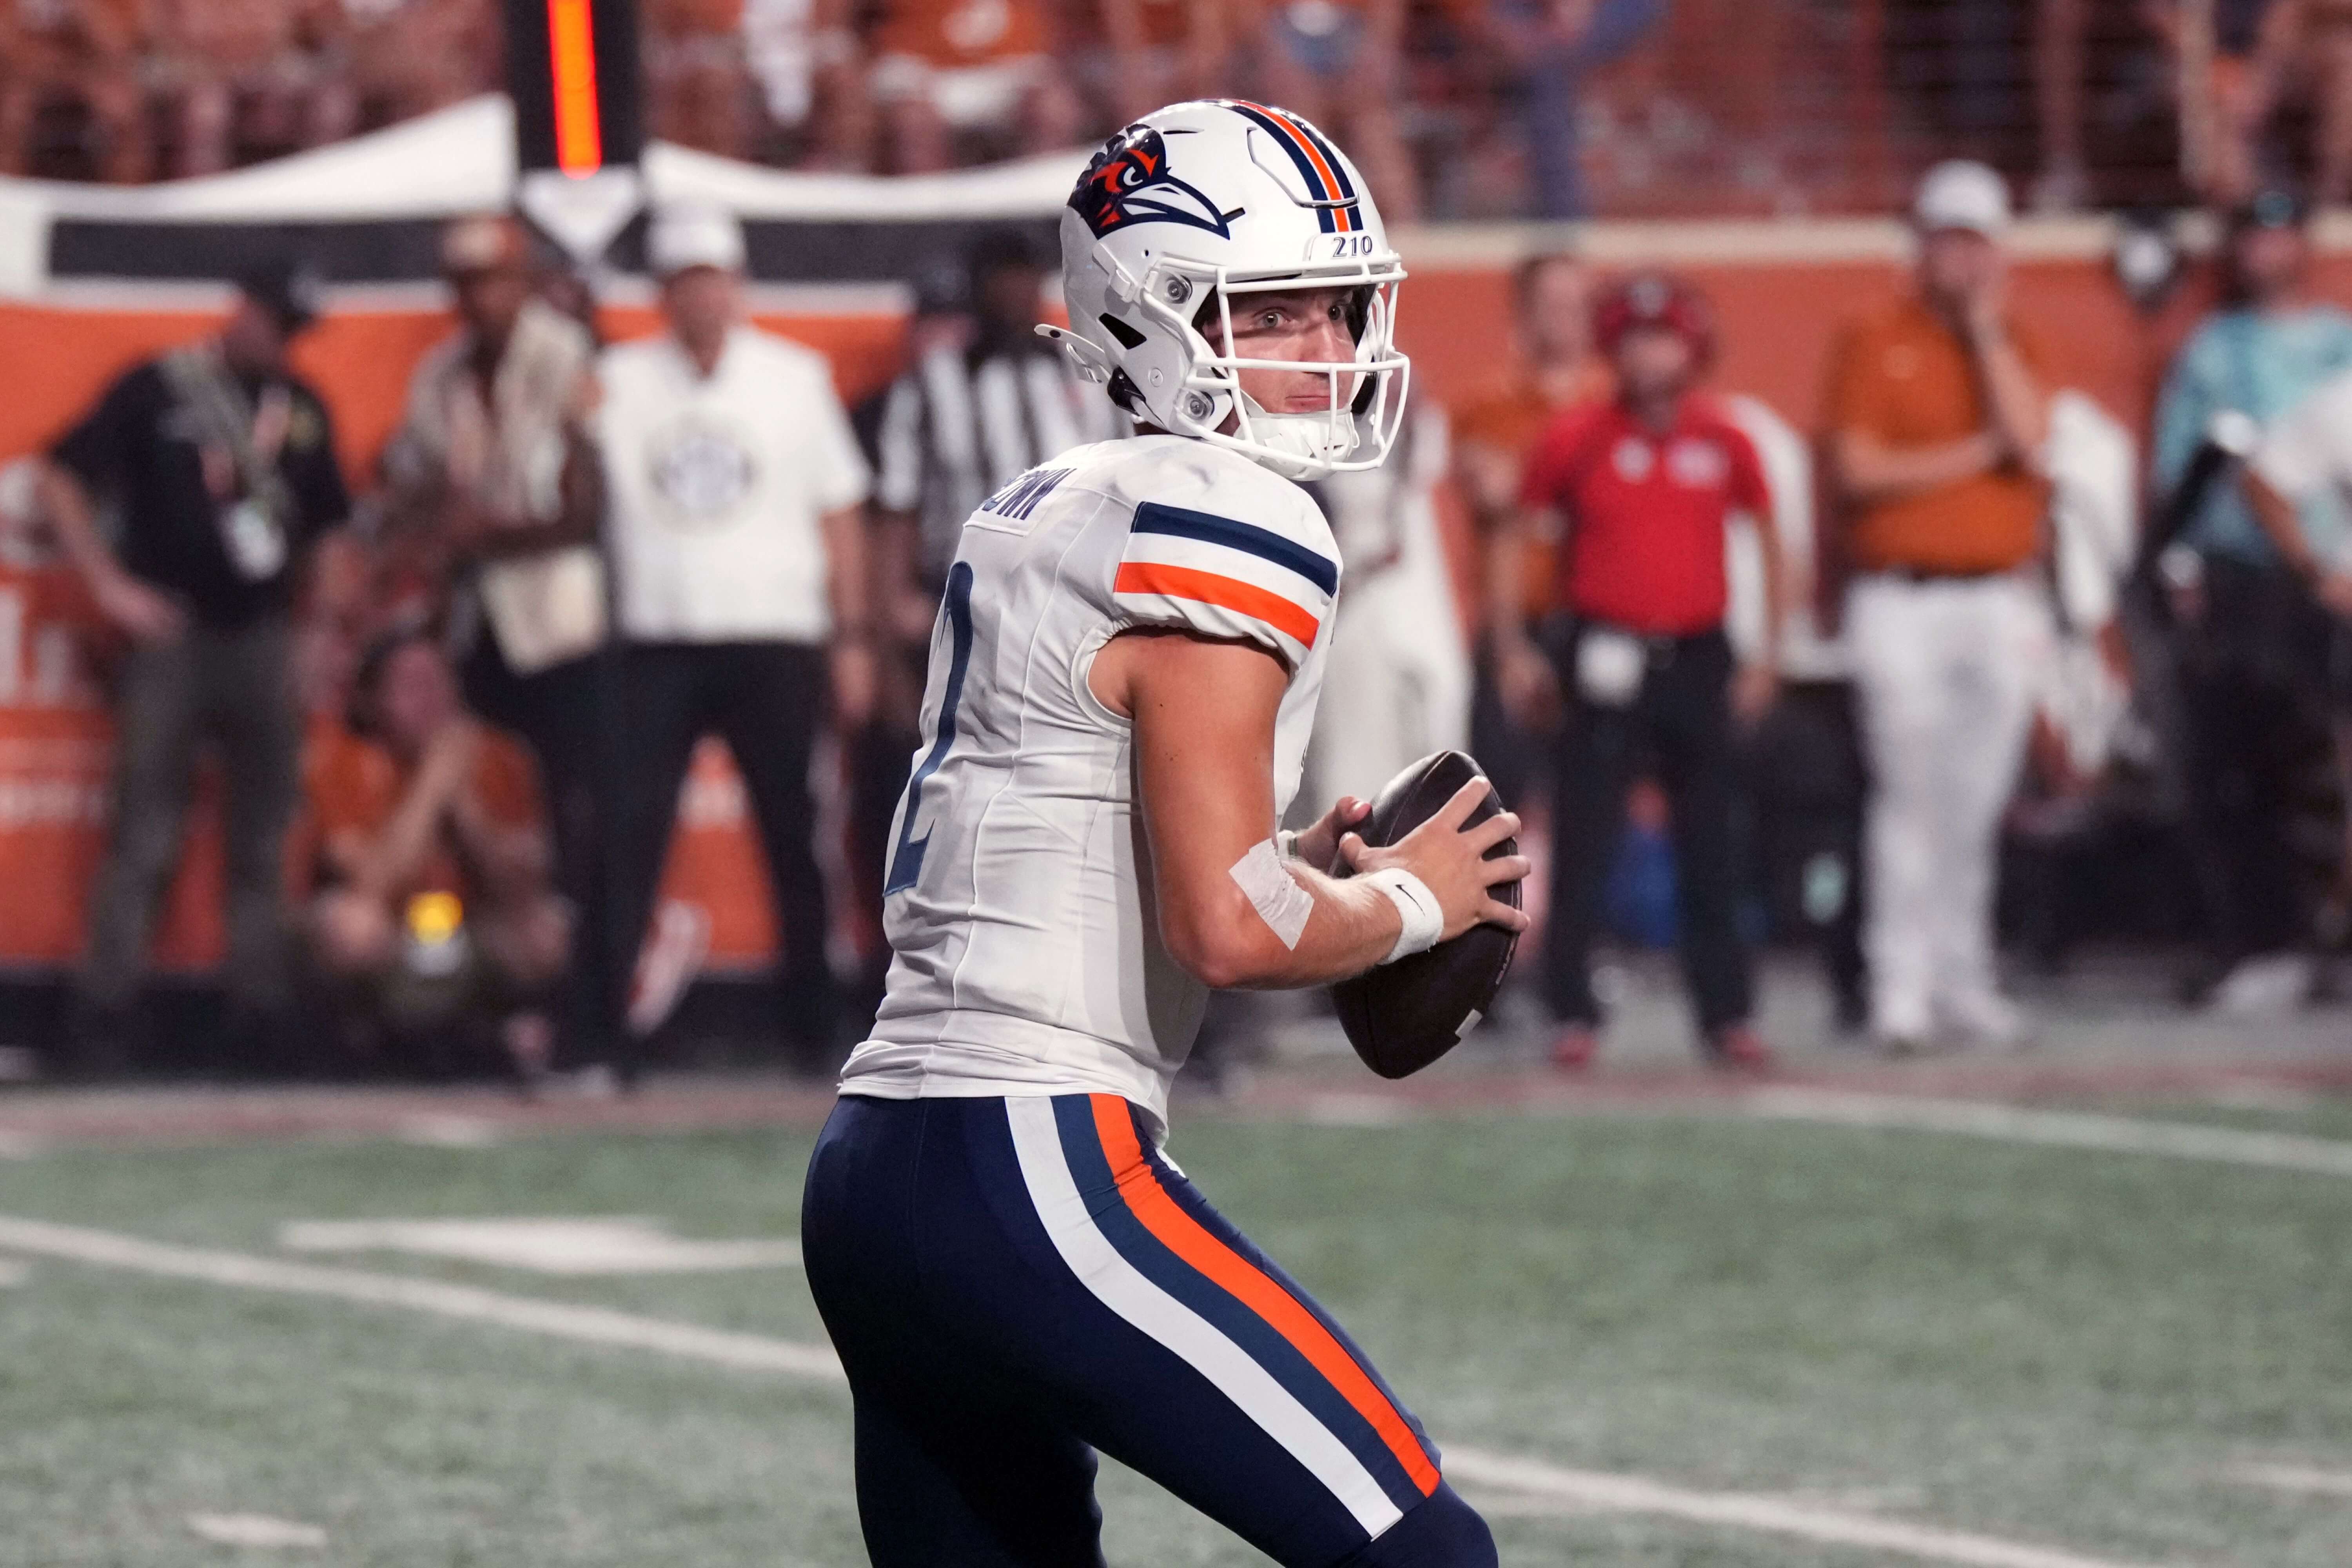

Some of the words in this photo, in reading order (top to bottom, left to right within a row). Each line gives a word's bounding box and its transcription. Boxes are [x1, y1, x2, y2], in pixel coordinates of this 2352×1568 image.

[1333, 236, 1373, 257] 210
[981, 468, 1077, 520] OWN
[884, 561, 973, 897] 2
